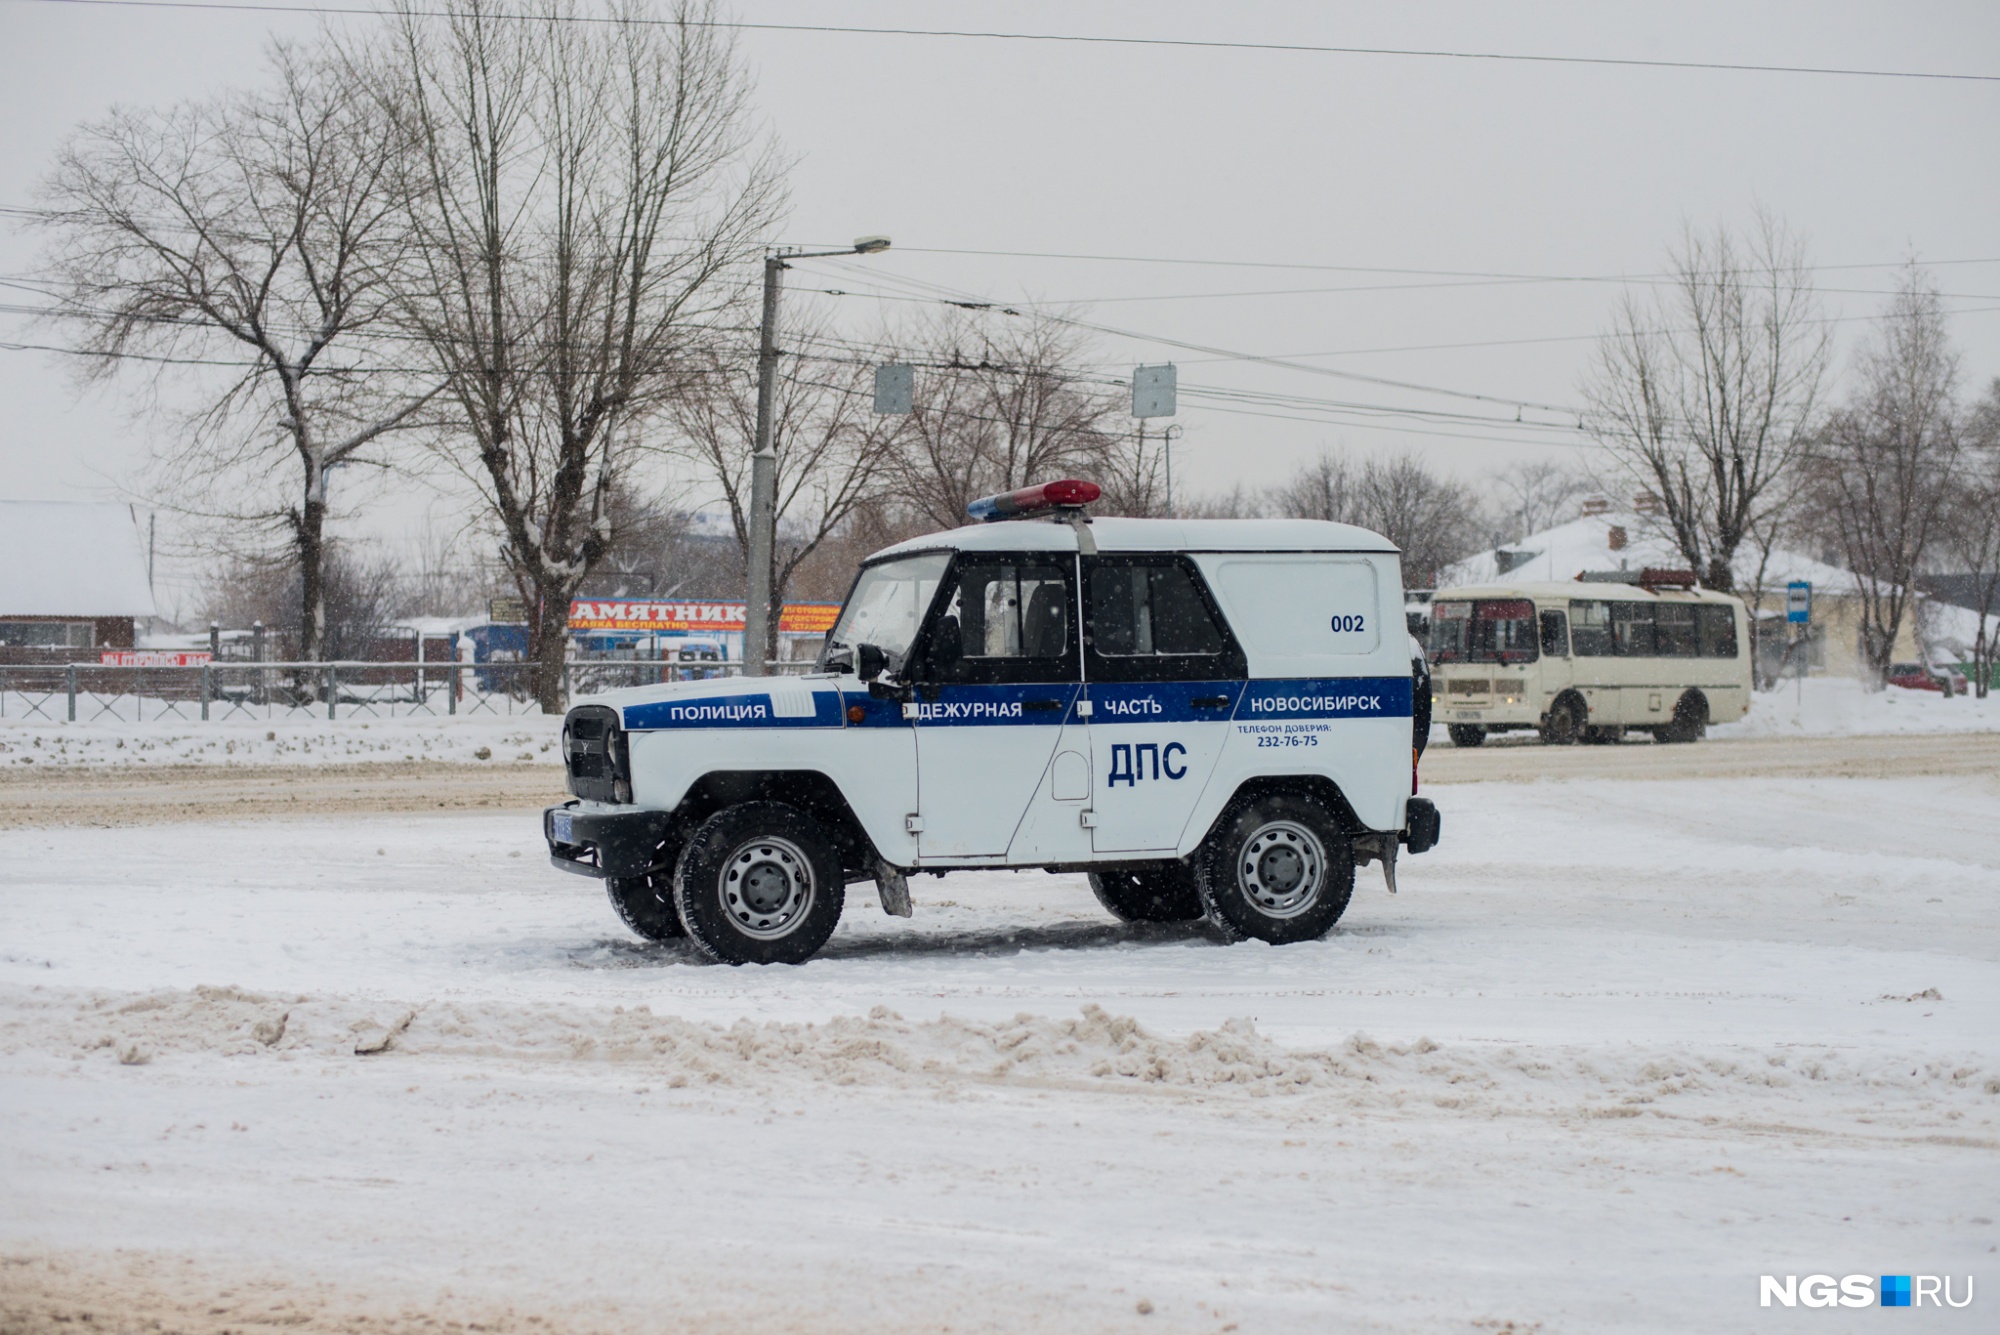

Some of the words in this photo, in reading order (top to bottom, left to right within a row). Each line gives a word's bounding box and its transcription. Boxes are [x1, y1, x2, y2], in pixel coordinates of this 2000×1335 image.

[575, 602, 746, 621] АМЯТНИК
[616, 621, 688, 629] БЕСПЛАТНО
[1331, 615, 1365, 632] 002
[919, 702, 1022, 720] ДЕЖУРНАЯ
[1104, 700, 1163, 715] ЧАСТЬ
[1251, 696, 1382, 712] НОВОСИБИРСК
[670, 705, 766, 720] ПОЛИЦИЯ
[1237, 725, 1282, 733] ТЕЛЕФОН
[1284, 724, 1332, 734] ДОВЕРИЯ:
[1257, 735, 1318, 747] 232-76-75
[1108, 742, 1187, 787] ДПС
